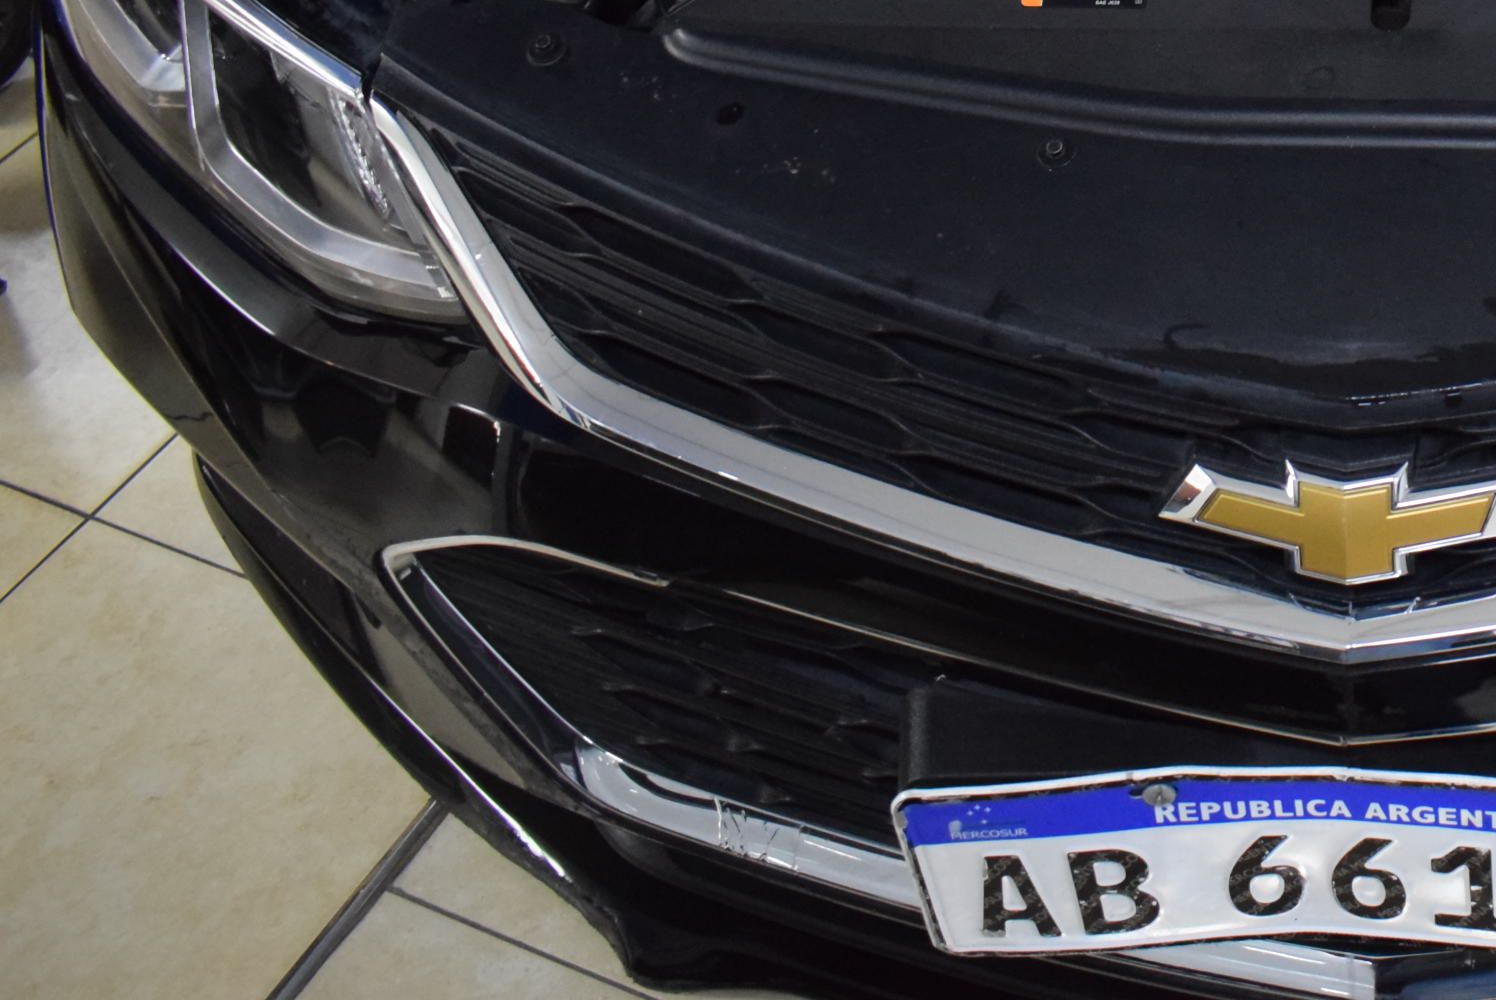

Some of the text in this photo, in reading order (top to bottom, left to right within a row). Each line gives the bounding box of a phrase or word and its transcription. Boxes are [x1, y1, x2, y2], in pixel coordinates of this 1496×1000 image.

[1154, 799, 1353, 824] REPUBLICA
[950, 827, 1029, 840] MERCOSUR
[982, 848, 1161, 937] AB
